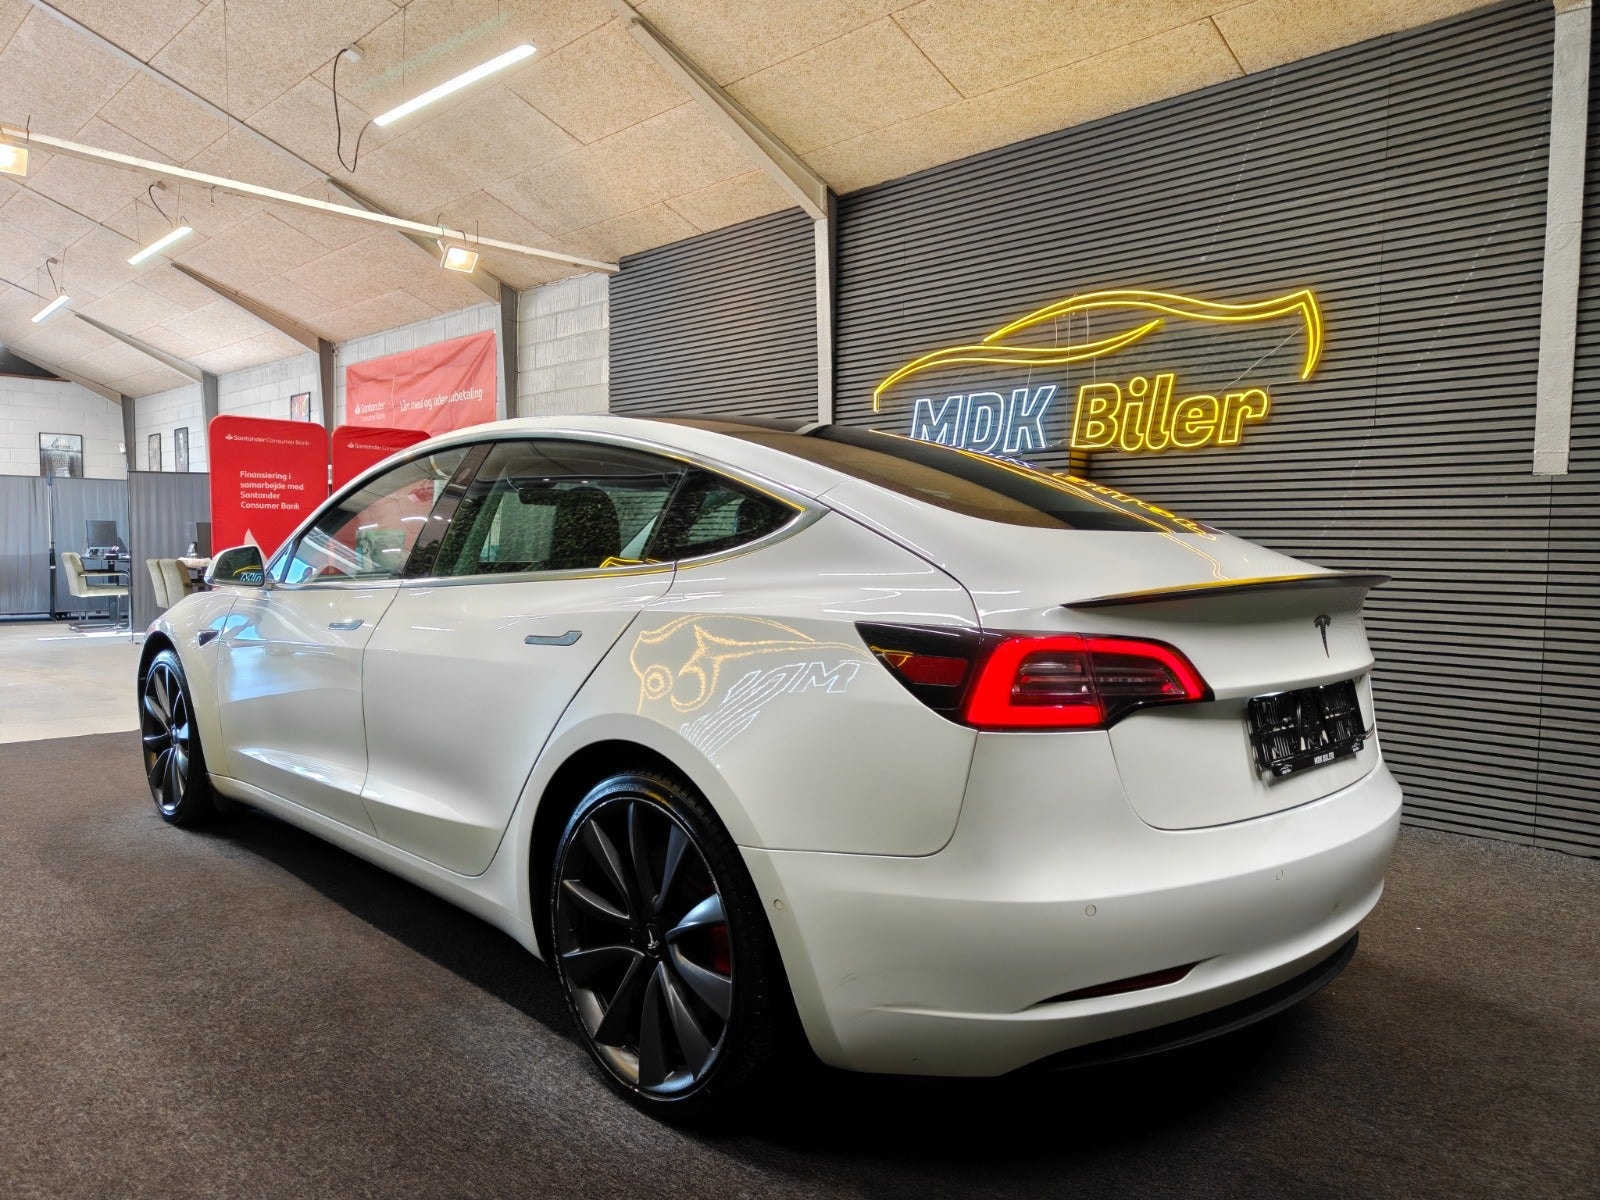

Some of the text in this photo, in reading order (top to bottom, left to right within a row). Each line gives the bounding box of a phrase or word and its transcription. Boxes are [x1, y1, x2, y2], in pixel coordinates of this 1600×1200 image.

[360, 401, 385, 414] Santander
[424, 398, 433, 411] og
[909, 373, 1268, 453] MDK Biler
[233, 435, 265, 443] Santander
[266, 437, 294, 445] Consumer
[240, 471, 287, 481] Finansiering
[240, 482, 286, 491] samarbejde
[240, 491, 280, 499] Santander
[240, 501, 300, 510] Consumer Bank
